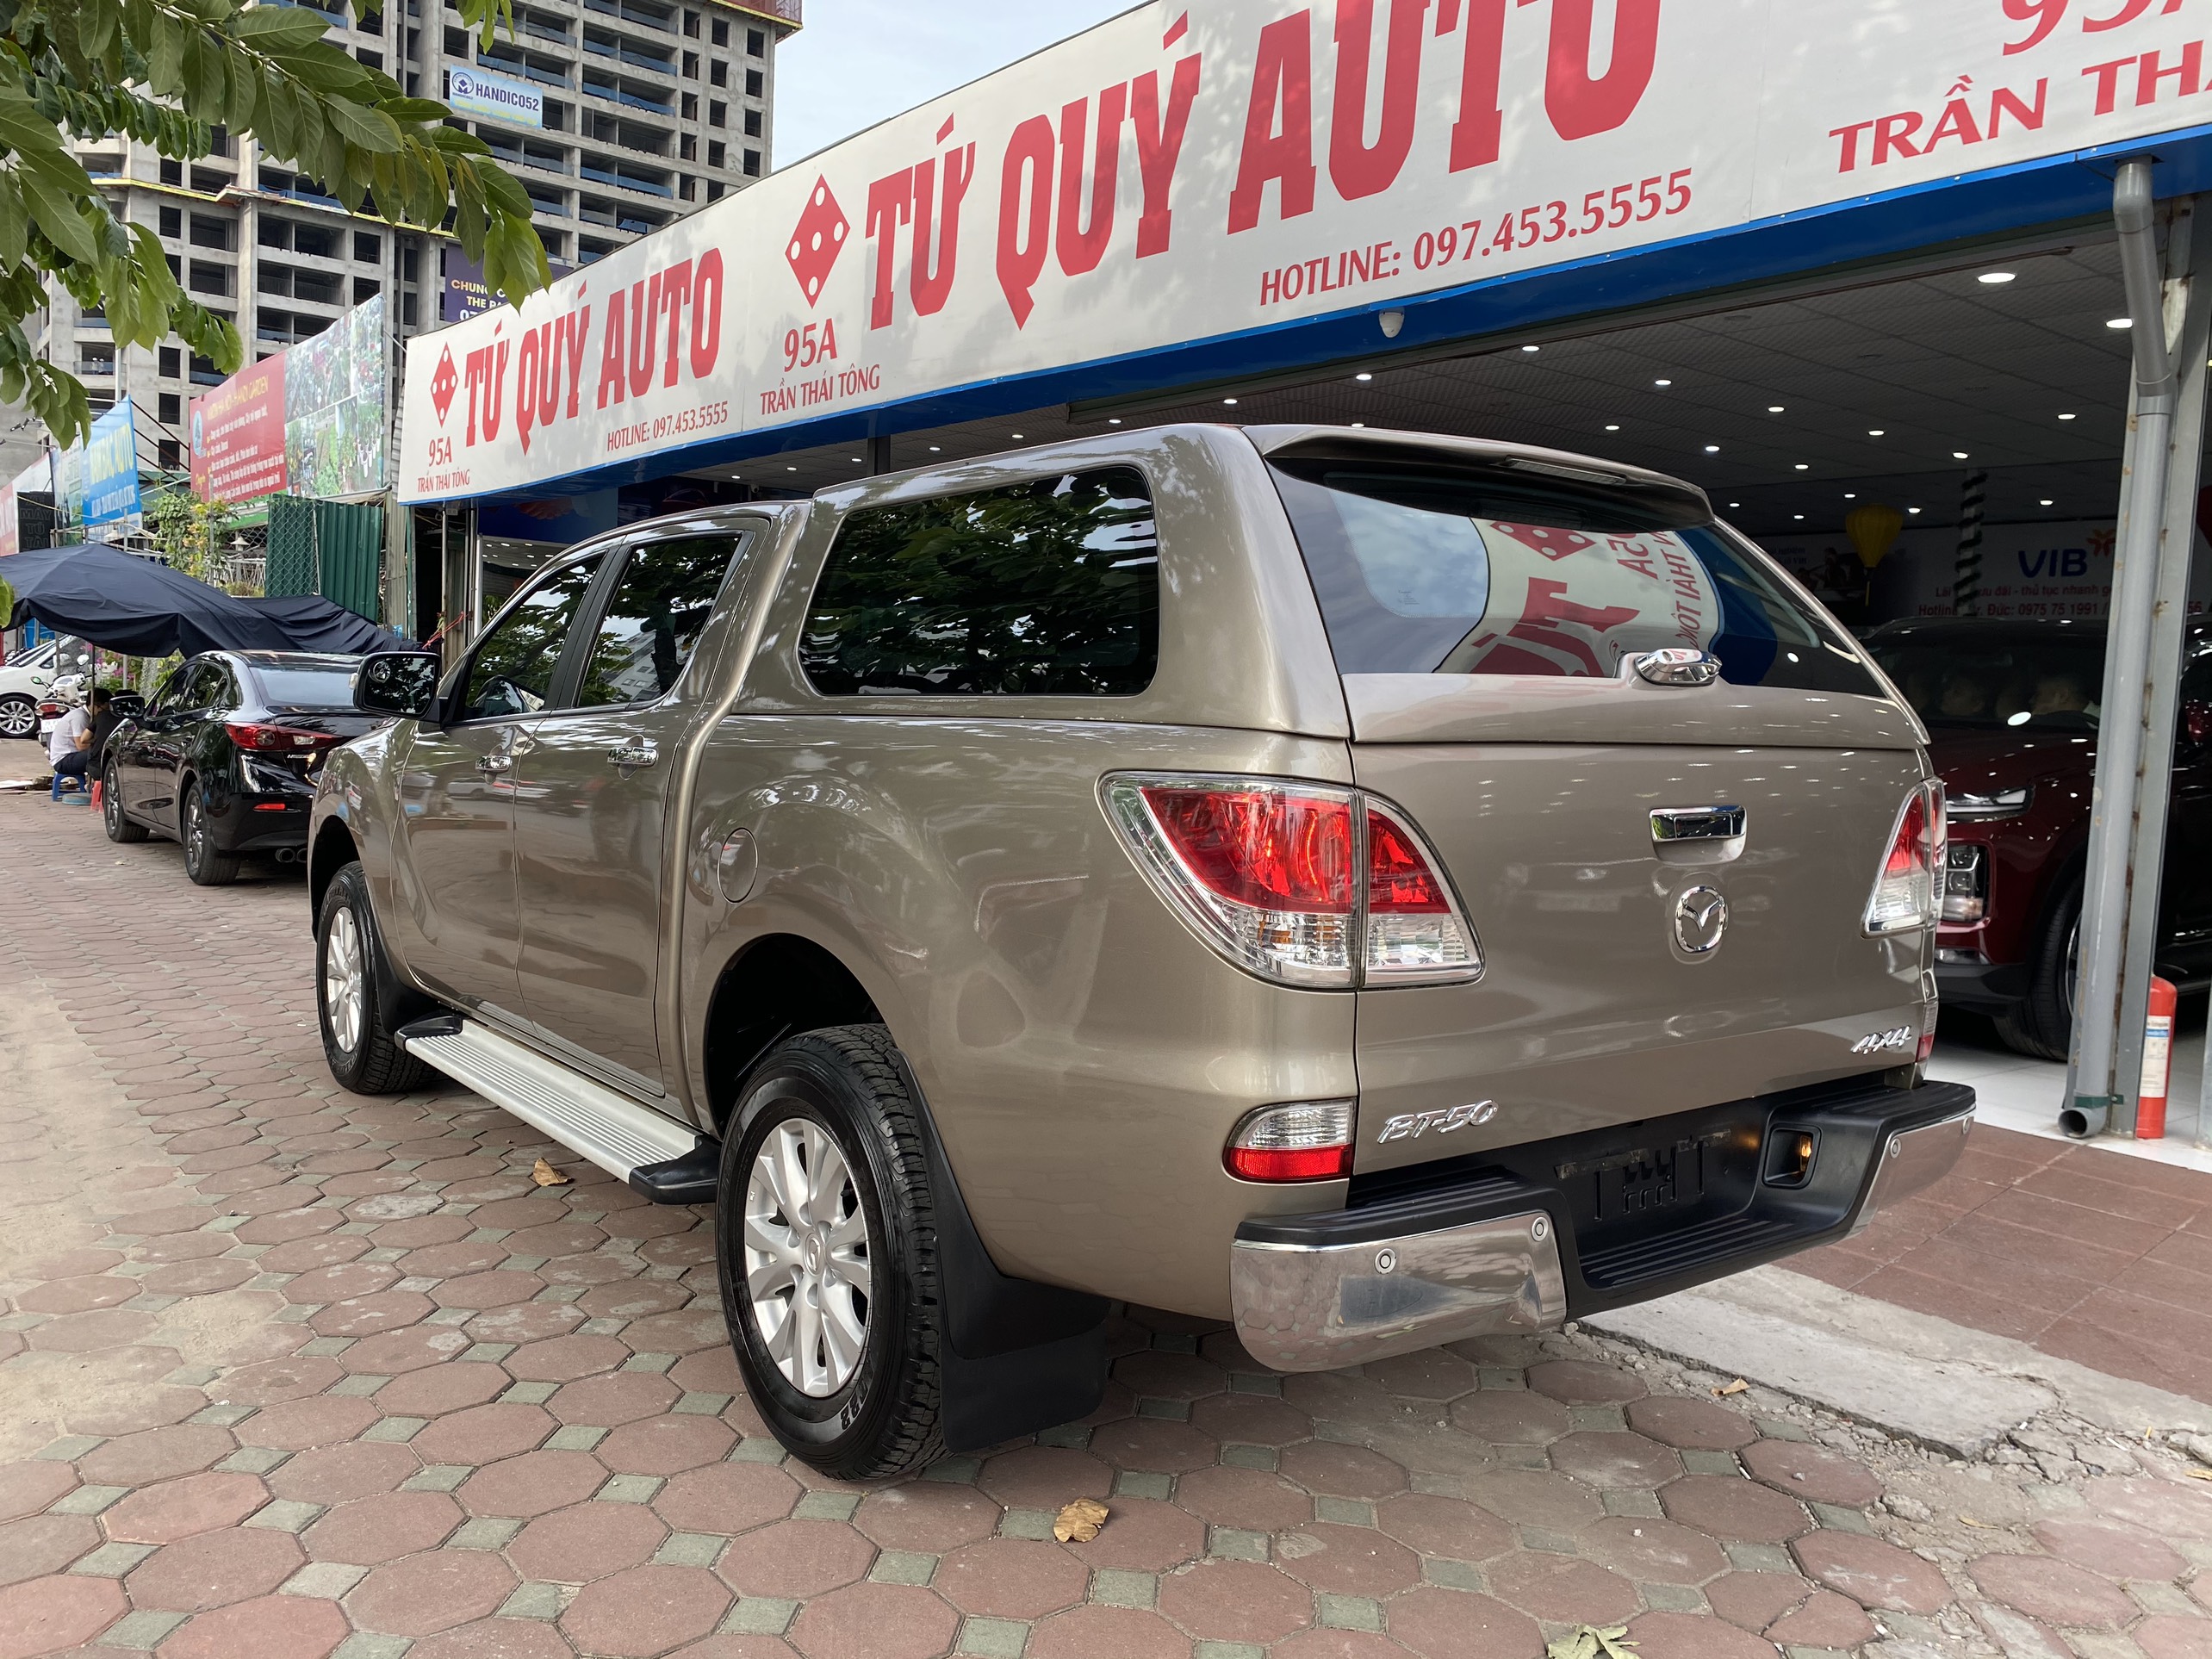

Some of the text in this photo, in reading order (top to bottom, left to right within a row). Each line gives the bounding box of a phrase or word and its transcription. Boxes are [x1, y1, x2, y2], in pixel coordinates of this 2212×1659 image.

[475, 83, 539, 112] HANDICO52
[1828, 75, 2048, 173] TRẦN
[864, 0, 1661, 331] TỨ QUÝ AUTO
[1259, 168, 1693, 306] HOTLINE: 097.453.5555
[466, 295, 487, 308] THE
[464, 248, 724, 457] TỨ QUÝ AUTO
[785, 318, 838, 372] 95A
[761, 363, 880, 415] TRẦN THÁI TÔNG
[606, 401, 729, 452] HOTLINE: 097.453.5555
[428, 436, 452, 467] 95A
[2018, 549, 2088, 578] VIB
[2018, 603, 2047, 615] 0975
[2051, 603, 2065, 615] 75
[2070, 603, 2097, 615] 1991
[2022, 584, 2039, 595] thủ
[2042, 586, 2059, 597] tục
[2062, 585, 2098, 594] nhanh
[1376, 1099, 1499, 1144] BT-50
